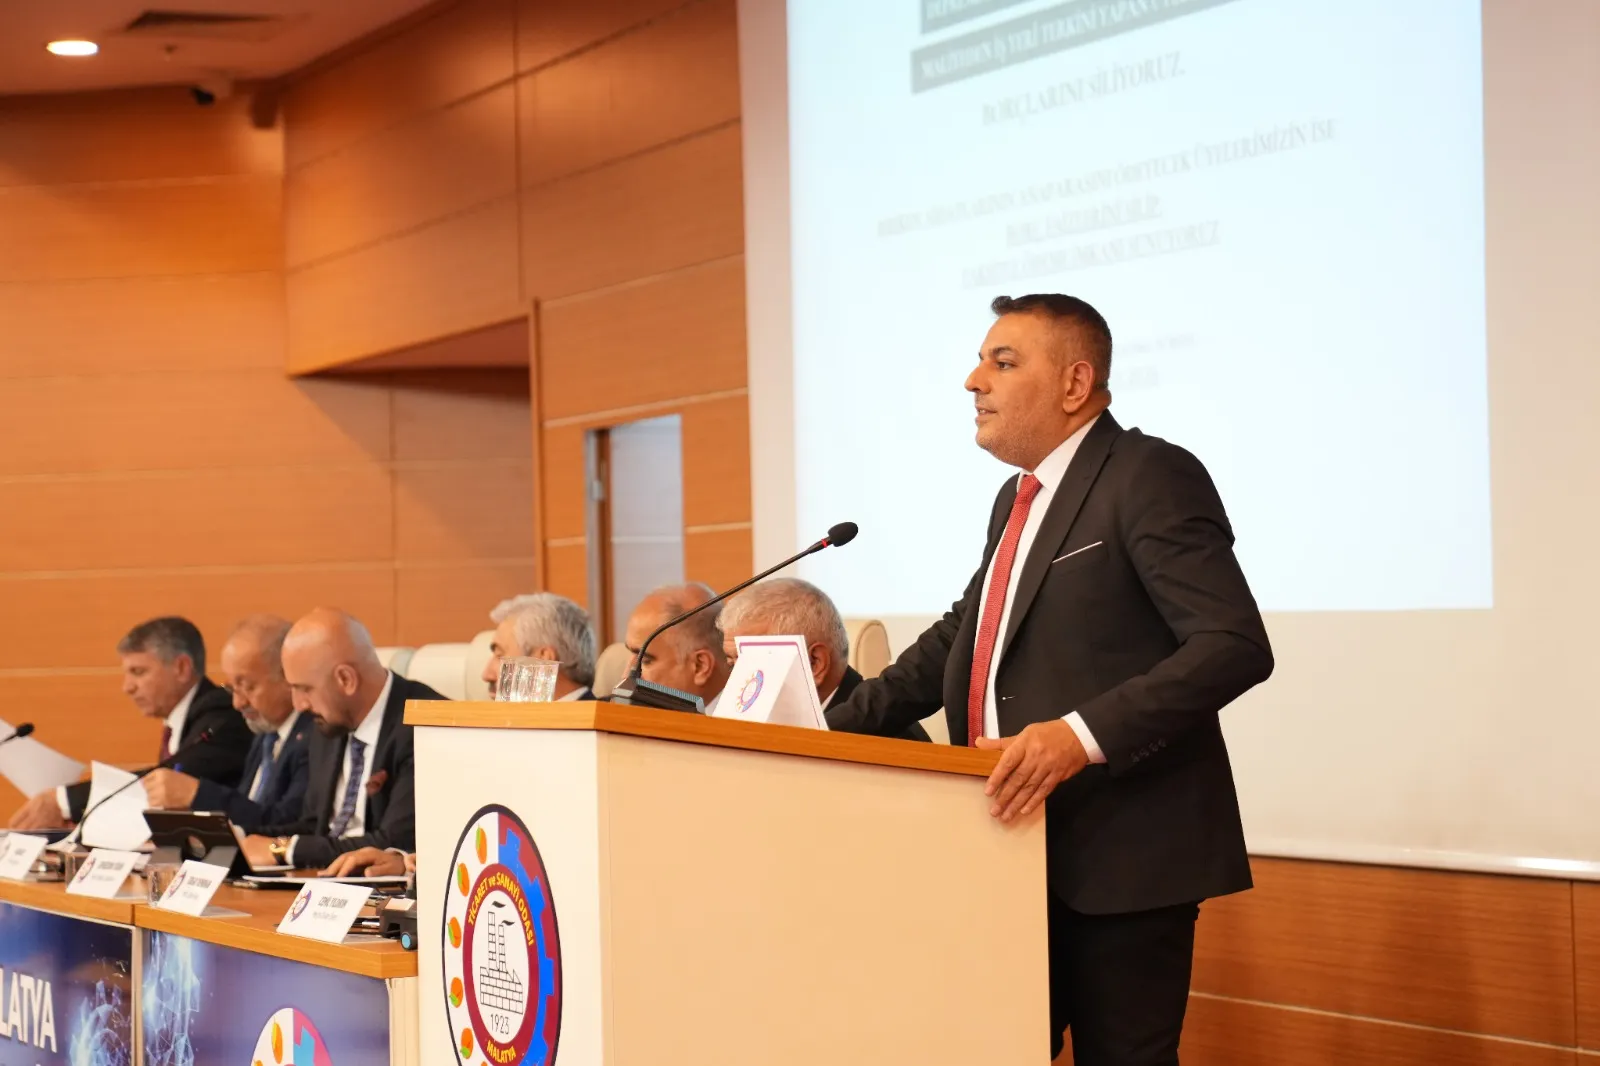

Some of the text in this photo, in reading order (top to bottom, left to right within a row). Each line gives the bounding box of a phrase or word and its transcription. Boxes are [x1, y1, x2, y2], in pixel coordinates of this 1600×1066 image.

[468, 877, 488, 926] TİCARET
[496, 872, 520, 902] SANAYİ
[518, 897, 534, 946] ODASI
[490, 1013, 510, 1035] 1923
[486, 1039, 517, 1064] MALATYA
